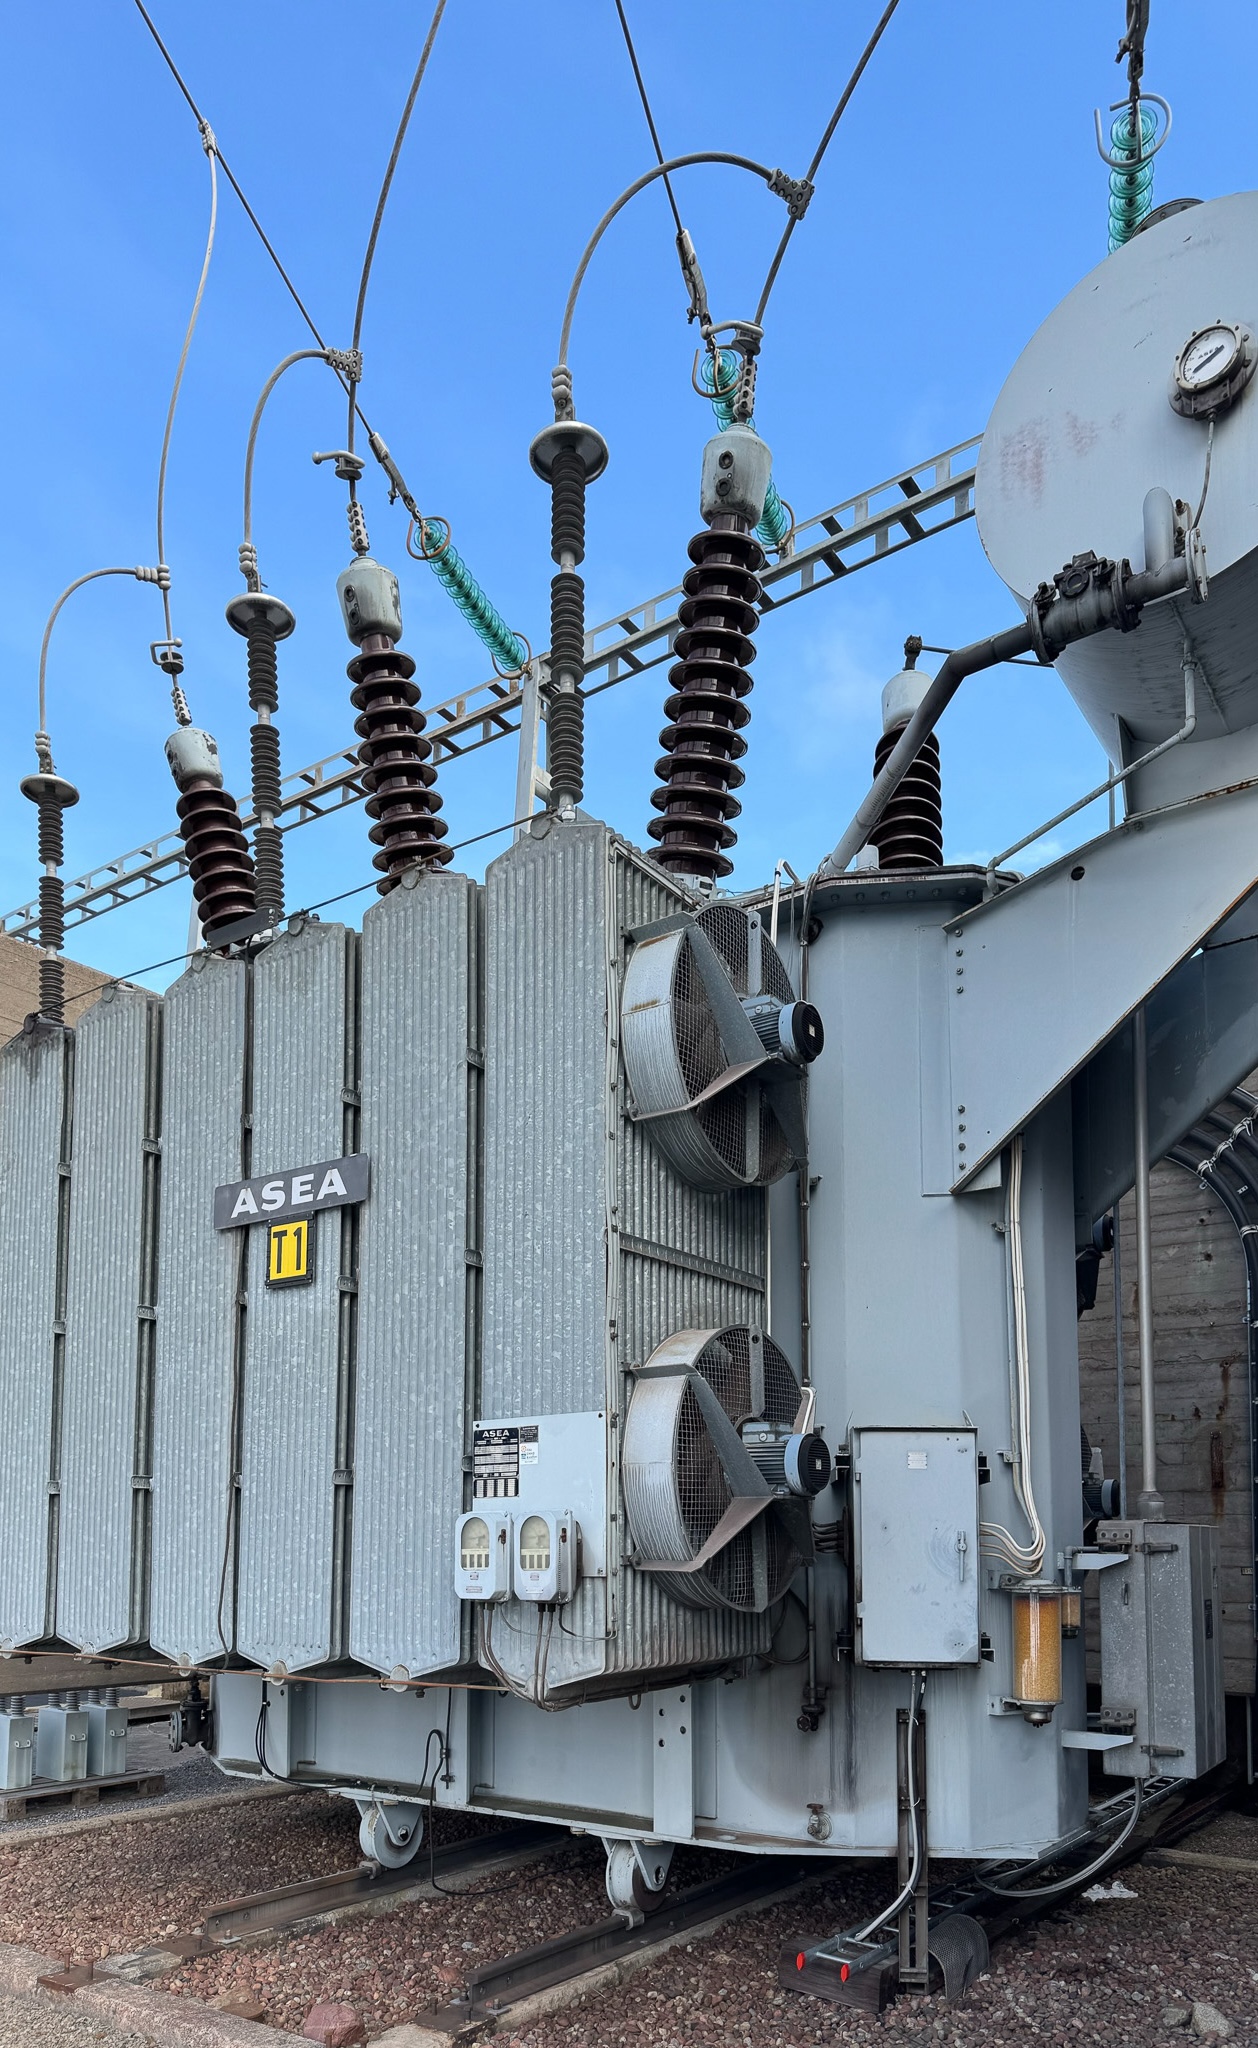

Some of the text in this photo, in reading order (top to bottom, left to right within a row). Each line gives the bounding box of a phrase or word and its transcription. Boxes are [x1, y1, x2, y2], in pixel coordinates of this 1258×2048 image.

[231, 1168, 348, 1218] ASEA
[273, 1226, 303, 1274] T1
[482, 1429, 510, 1438] ASEA
